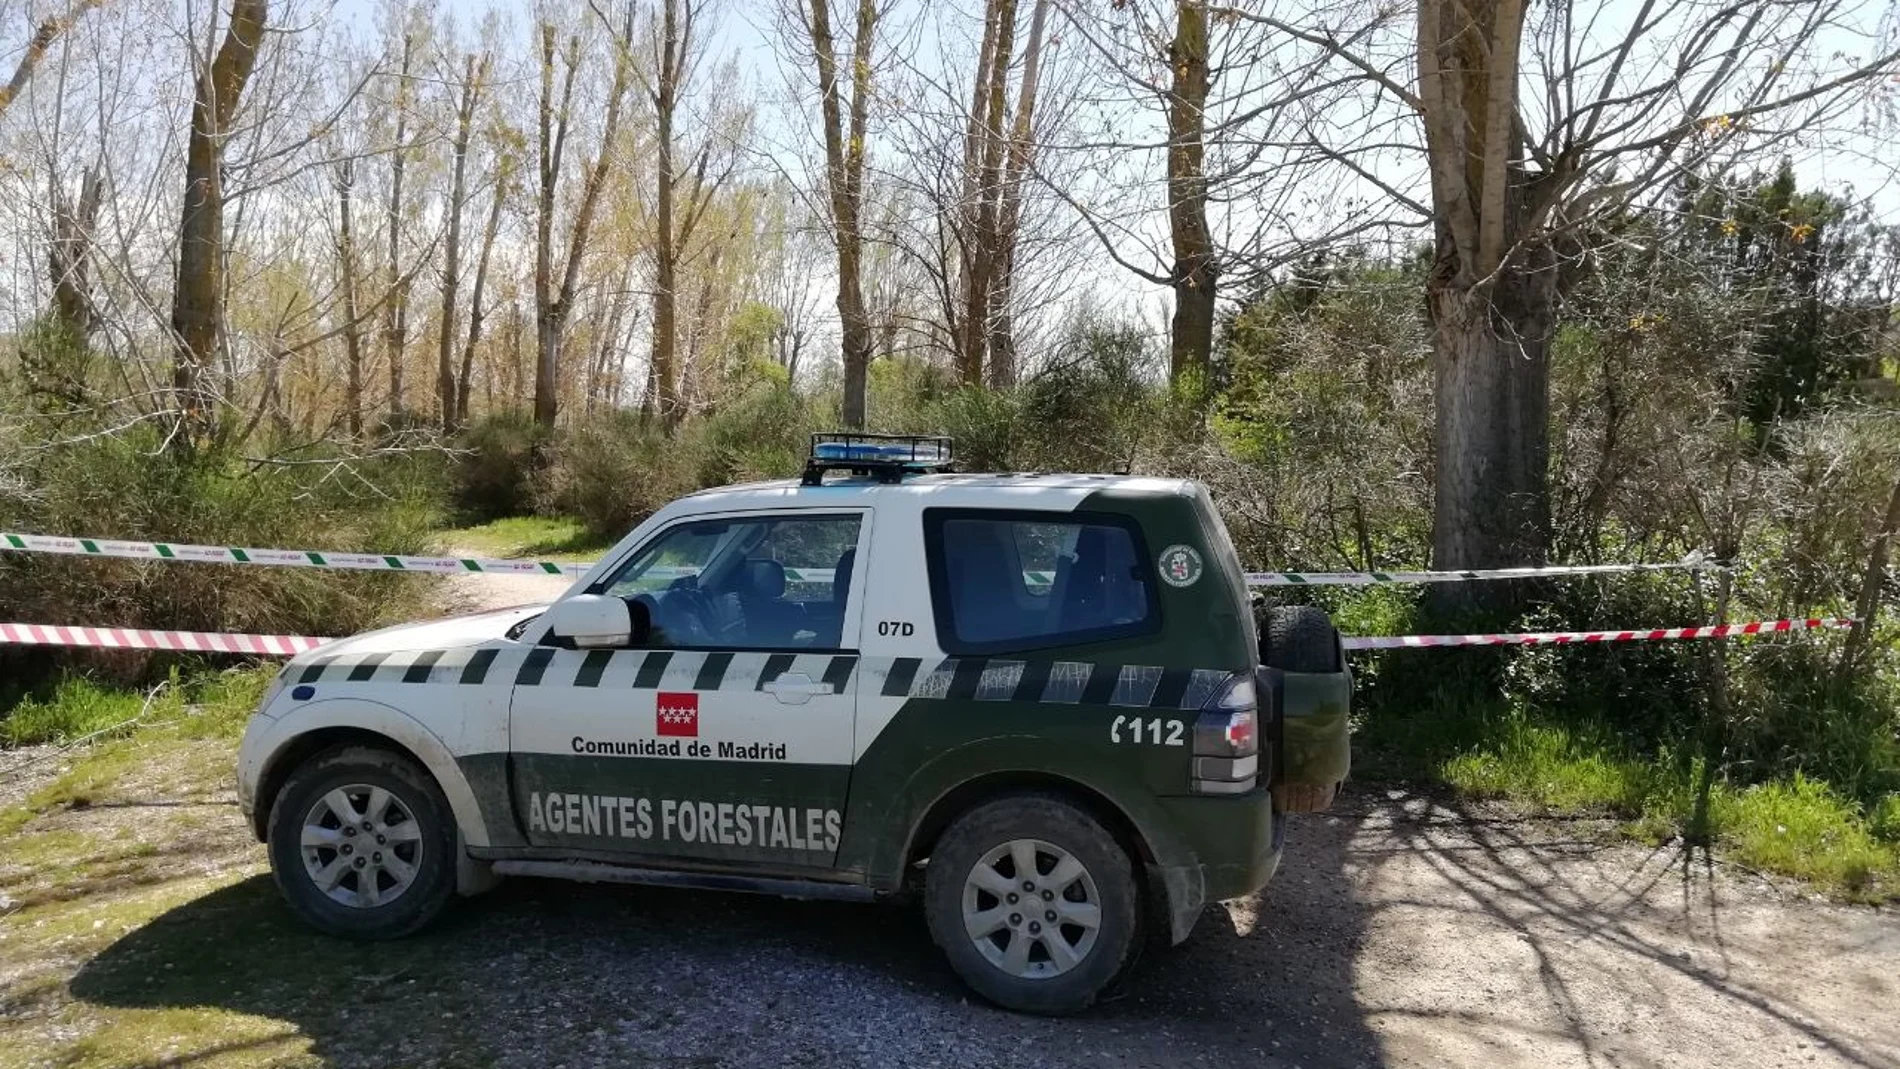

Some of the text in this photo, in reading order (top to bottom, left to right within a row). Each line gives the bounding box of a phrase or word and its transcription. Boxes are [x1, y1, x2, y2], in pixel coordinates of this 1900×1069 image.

[878, 621, 914, 636] 07D
[1128, 716, 1184, 746] 112
[571, 736, 786, 760] Comunidad de Madrid
[529, 791, 841, 852] AGENTES FORESTALES
